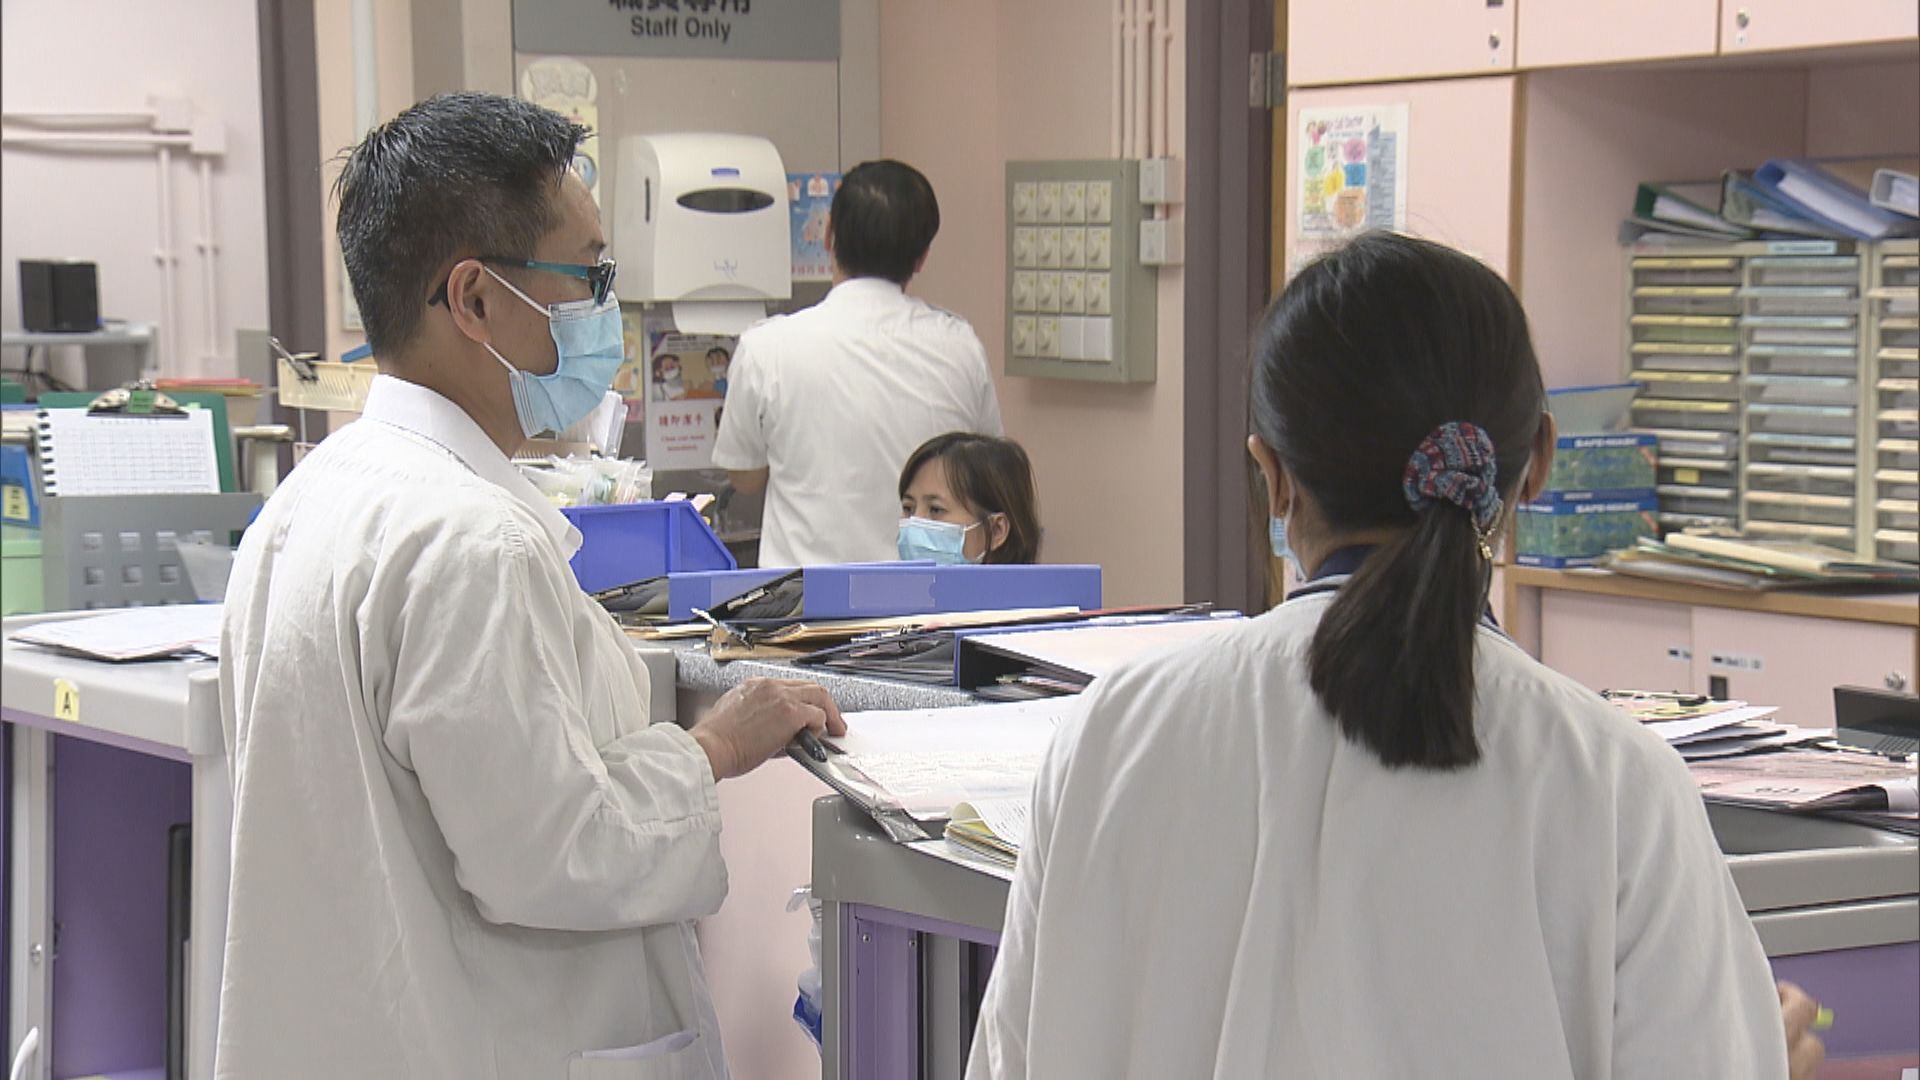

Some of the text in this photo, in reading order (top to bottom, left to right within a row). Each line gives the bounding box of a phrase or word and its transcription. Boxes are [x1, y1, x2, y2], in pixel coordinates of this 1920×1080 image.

[630, 15, 731, 44] Staff Only
[61, 690, 72, 715] A
